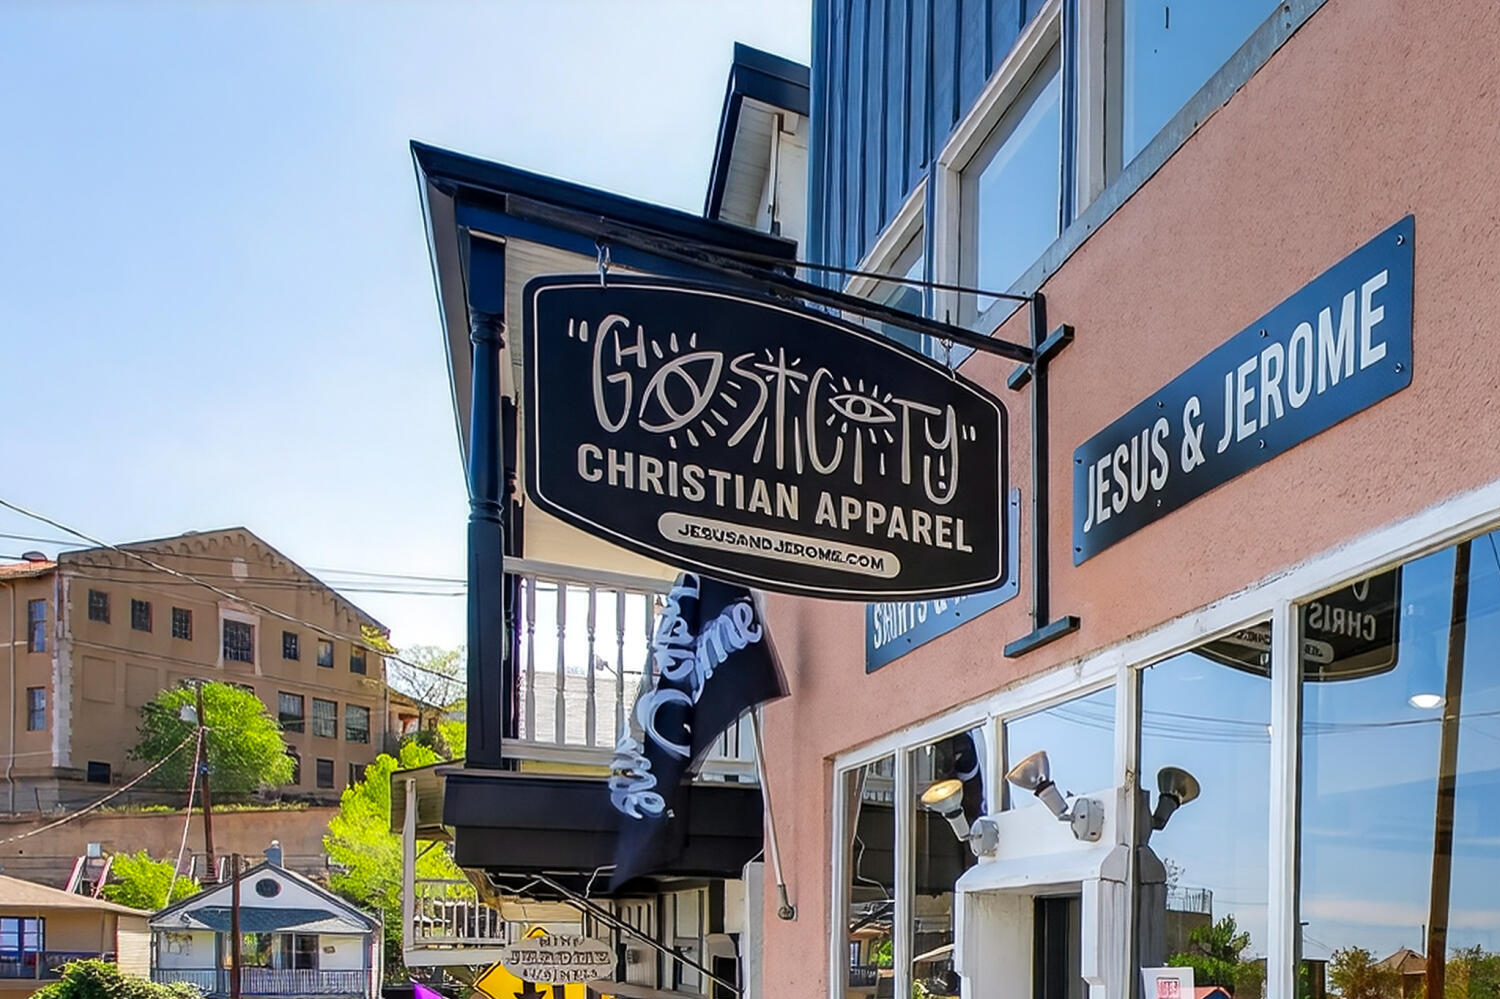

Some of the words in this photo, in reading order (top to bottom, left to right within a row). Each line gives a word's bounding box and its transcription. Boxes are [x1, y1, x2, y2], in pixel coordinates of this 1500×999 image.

[1083, 417, 1169, 533] JESUS
[1181, 396, 1205, 473] &
[1217, 269, 1388, 453] JEROME
[577, 443, 799, 521] CHRISTIAN
[814, 491, 973, 554] APPAREL
[678, 523, 885, 572] JESUSANDJEROME.COM
